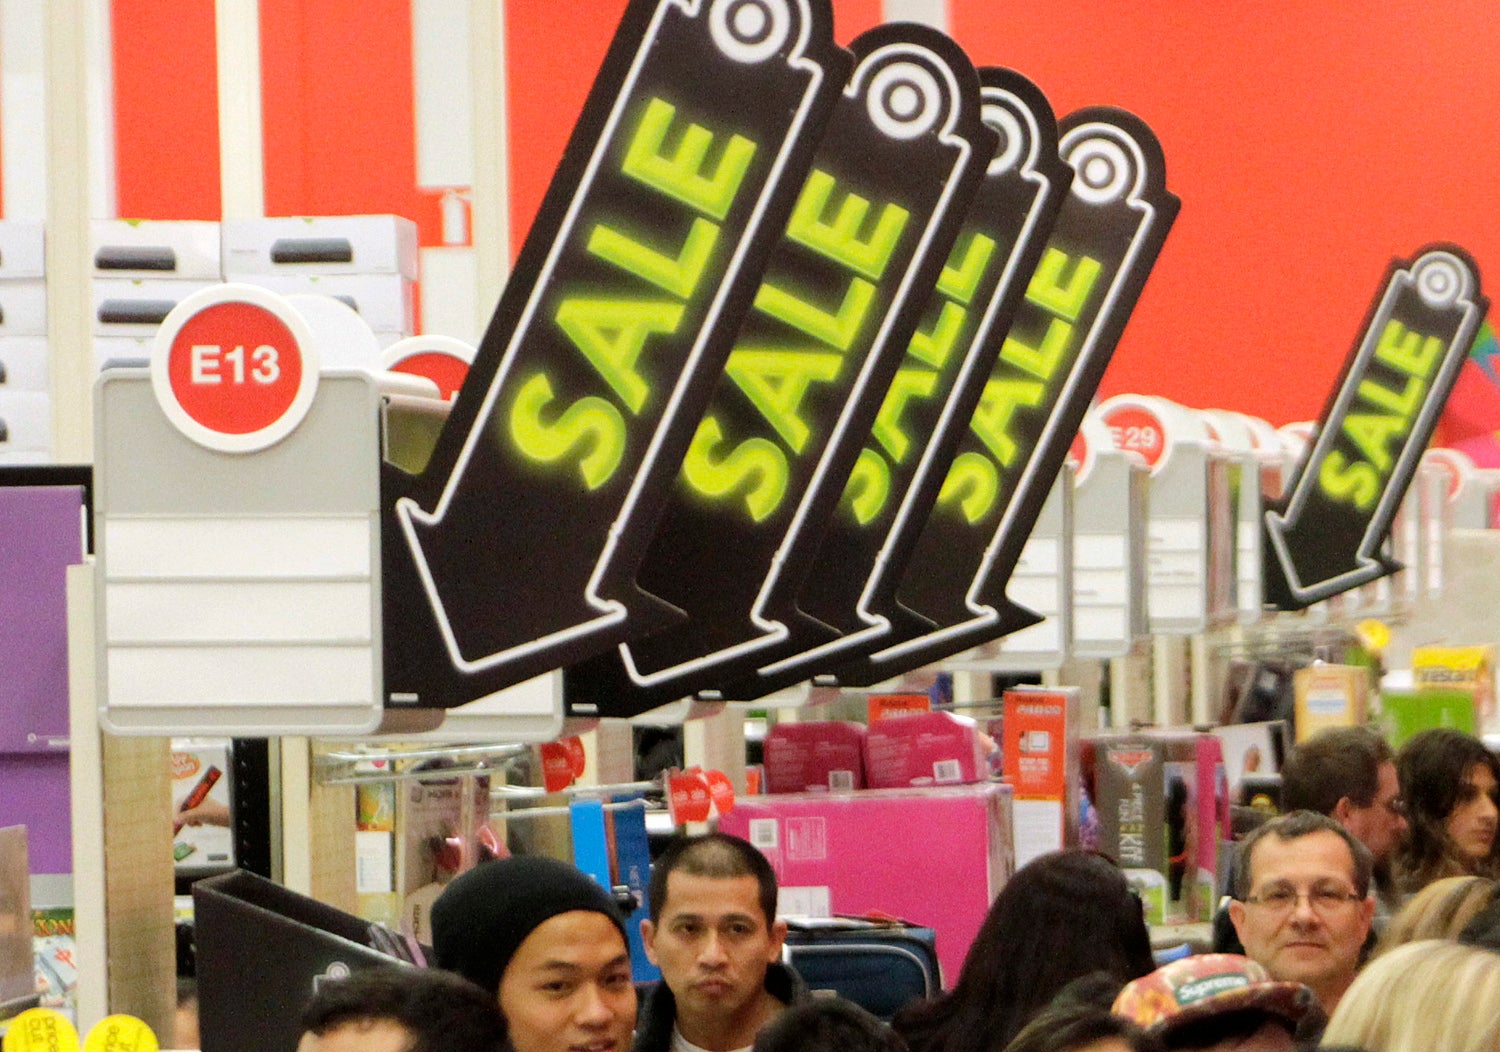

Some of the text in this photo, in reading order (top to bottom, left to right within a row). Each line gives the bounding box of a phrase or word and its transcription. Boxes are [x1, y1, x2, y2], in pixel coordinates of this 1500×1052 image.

[191, 344, 281, 385] E13
[510, 97, 757, 491] SALE
[682, 169, 909, 523] SALE
[1319, 319, 1443, 510] SALE
